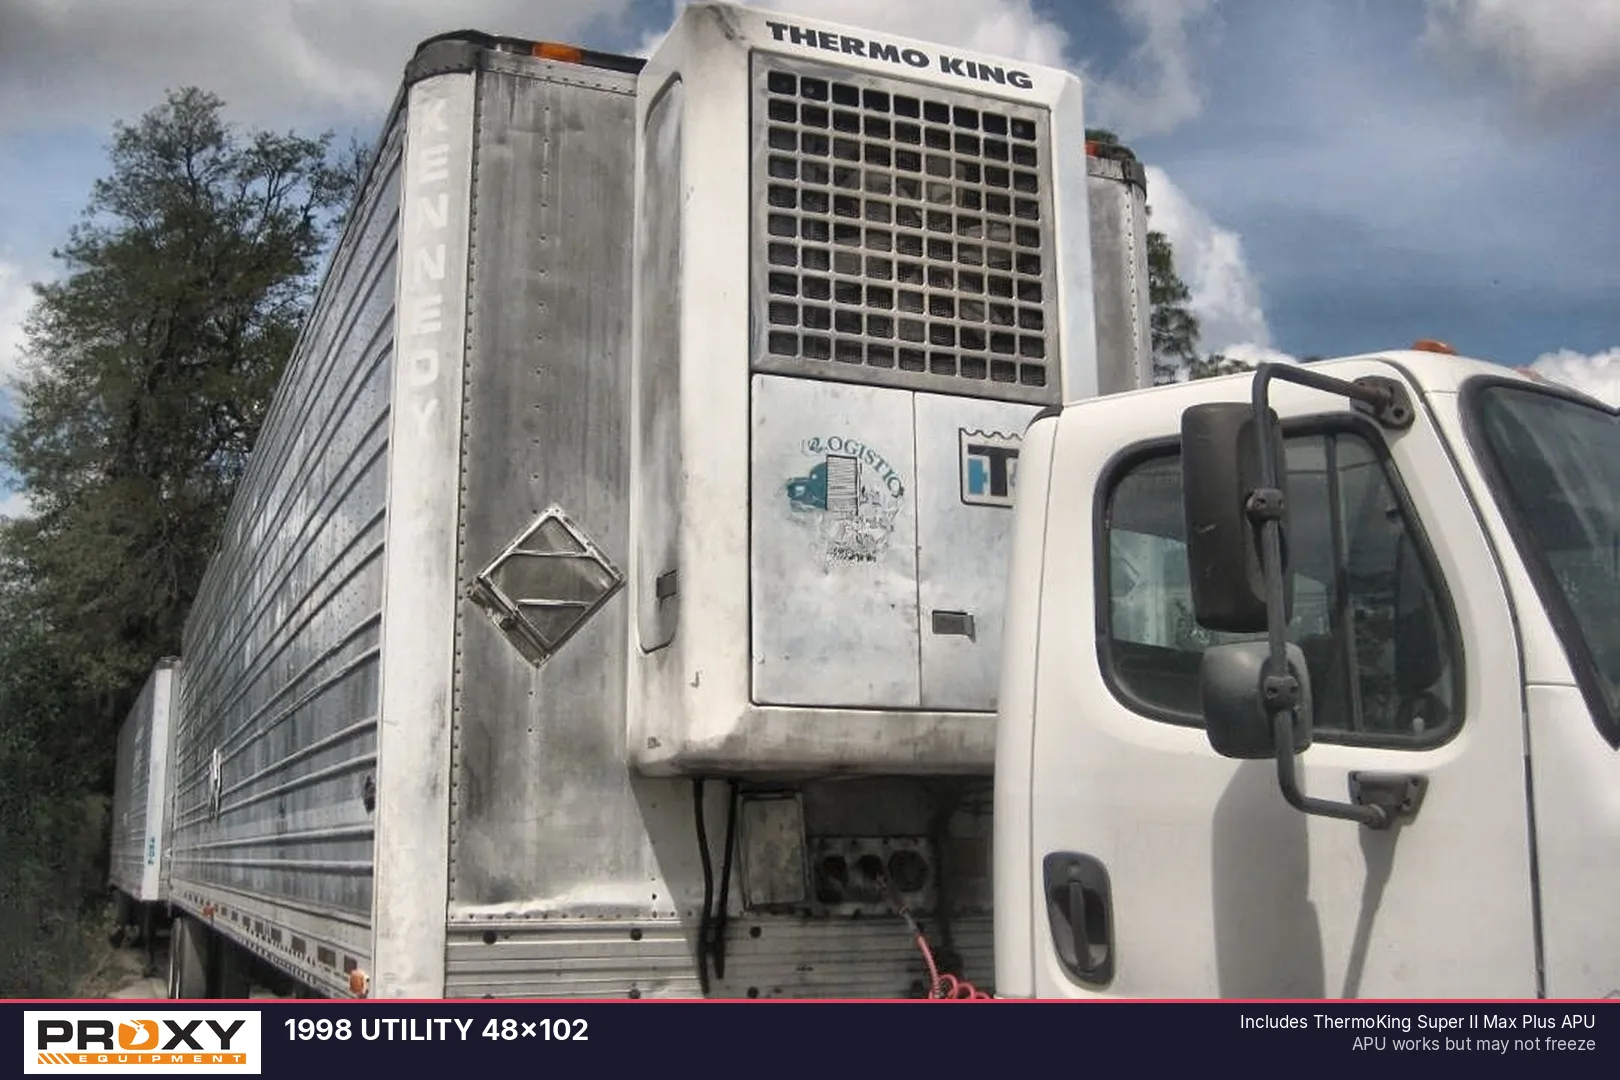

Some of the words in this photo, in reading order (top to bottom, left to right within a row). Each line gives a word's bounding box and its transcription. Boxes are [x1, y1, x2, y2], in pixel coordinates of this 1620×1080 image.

[766, 21, 930, 68] THERMO
[939, 55, 1033, 89] KING
[410, 98, 449, 437] KENNEDY
